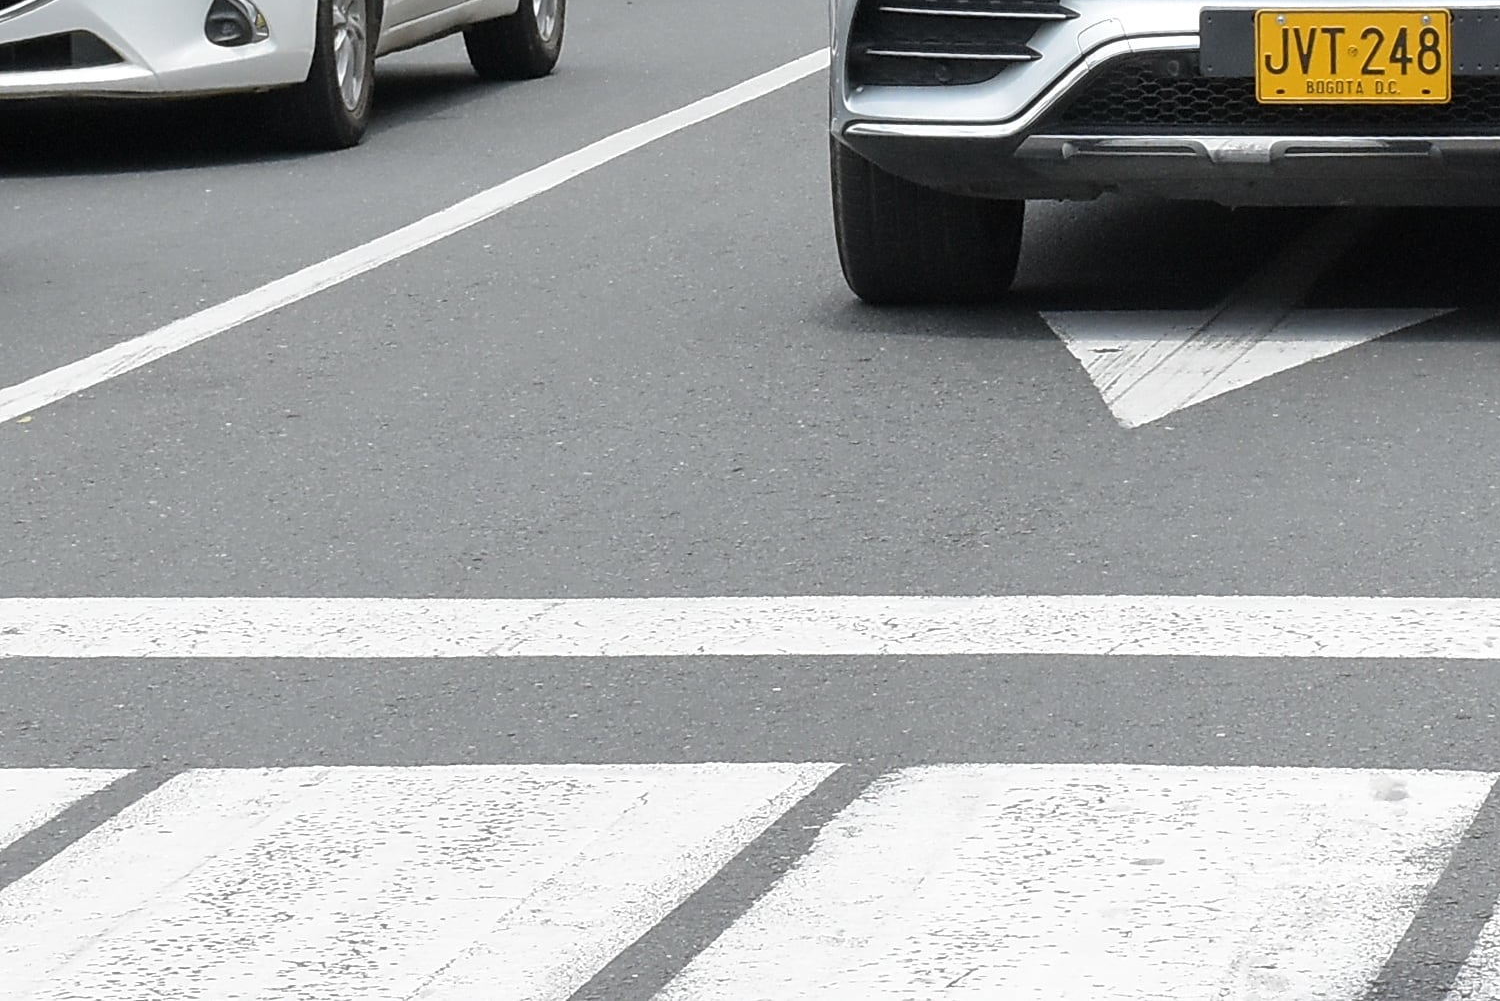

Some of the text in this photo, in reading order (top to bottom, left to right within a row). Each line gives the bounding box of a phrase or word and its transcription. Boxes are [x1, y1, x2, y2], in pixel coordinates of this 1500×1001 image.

[1264, 26, 1442, 75] JVT 248
[1306, 80, 1401, 94] BOGOTA D.C.
